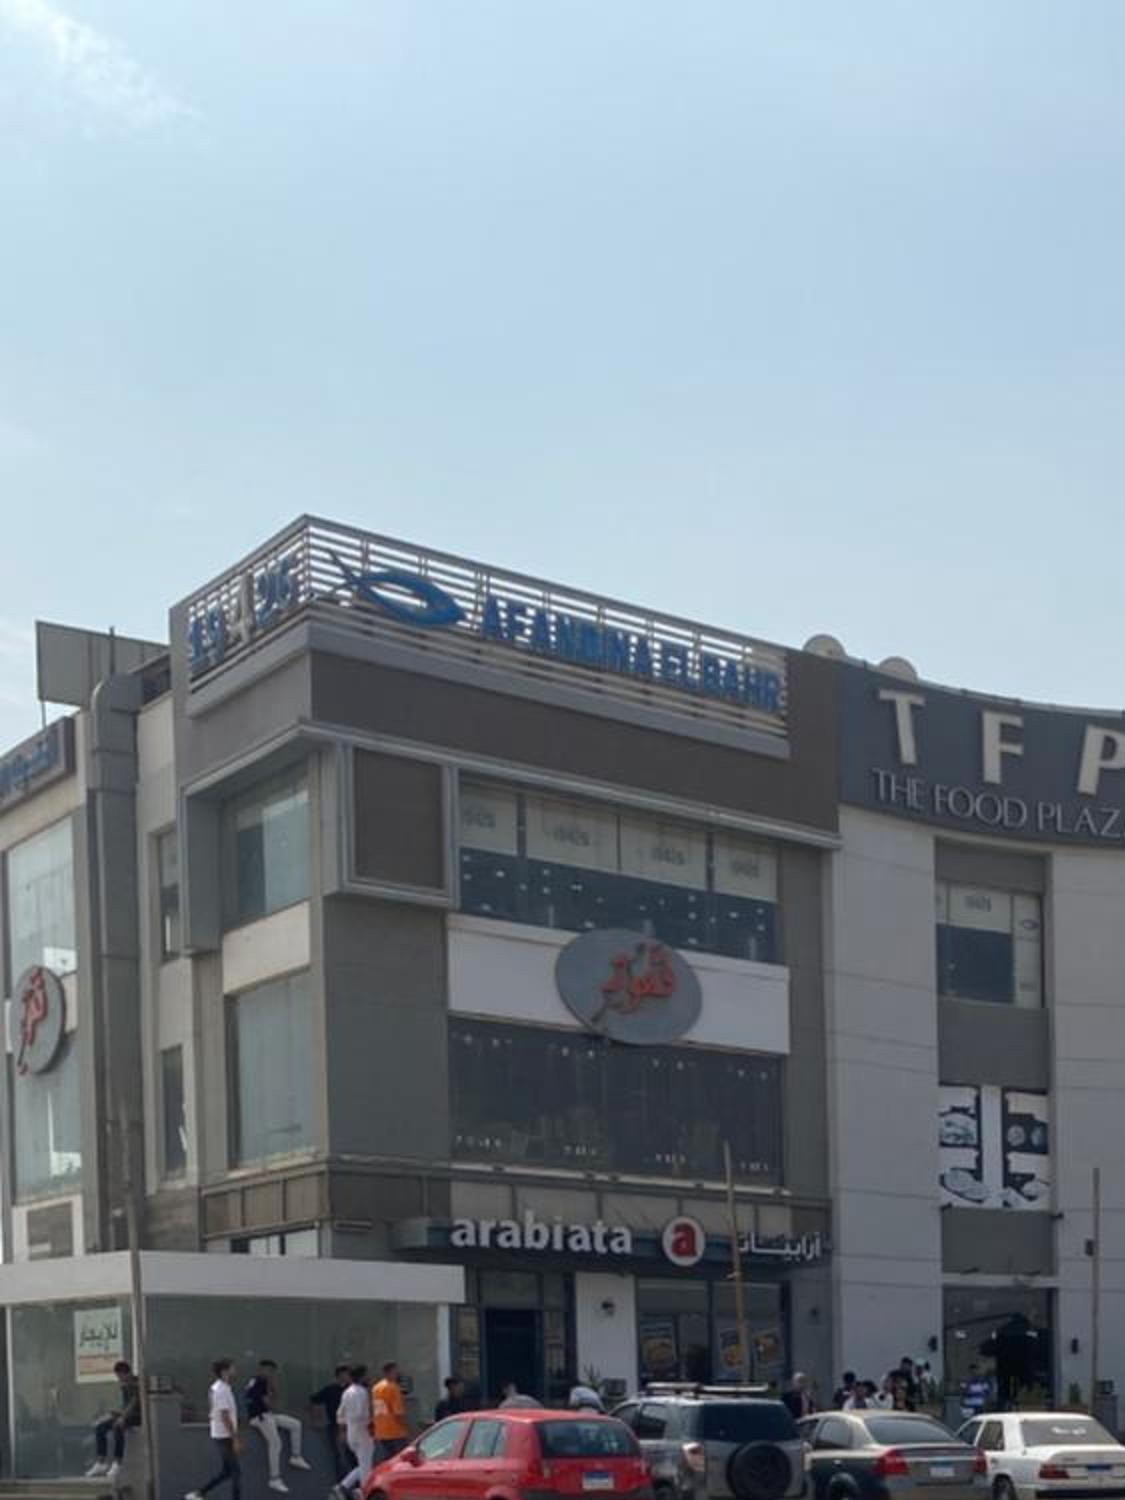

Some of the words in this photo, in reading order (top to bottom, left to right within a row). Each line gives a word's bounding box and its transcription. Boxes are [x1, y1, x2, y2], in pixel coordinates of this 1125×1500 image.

[871, 767, 927, 810] THE
[934, 782, 1028, 829] FOOD
[449, 1210, 632, 1256] arabiata
